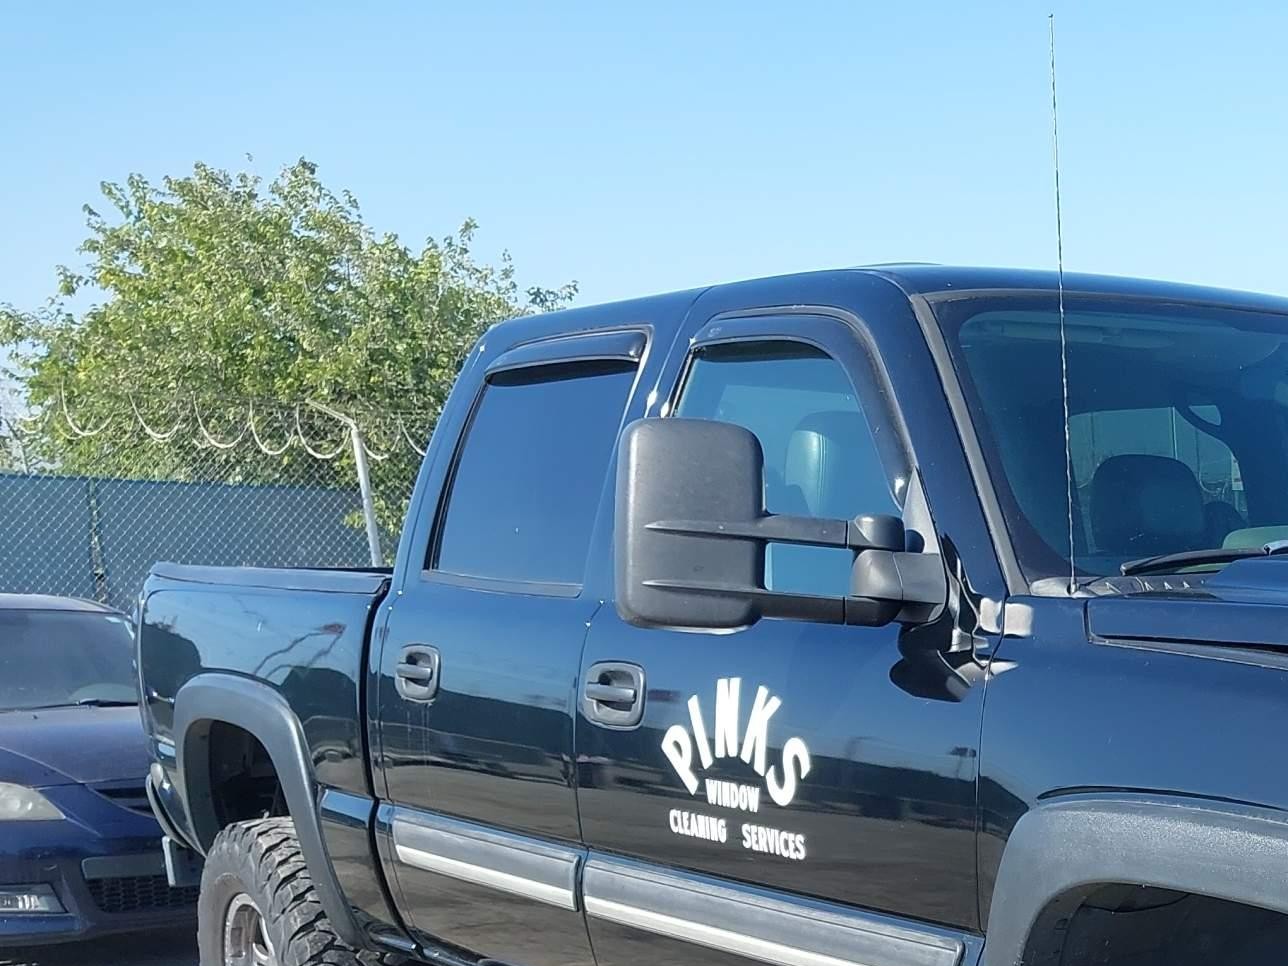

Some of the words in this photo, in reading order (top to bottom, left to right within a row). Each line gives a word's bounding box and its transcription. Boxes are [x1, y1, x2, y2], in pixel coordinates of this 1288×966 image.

[661, 677, 811, 807] PINKS
[705, 778, 760, 813] WINDOW
[669, 809, 727, 843] CLEANING
[741, 823, 806, 860] SERVICES
